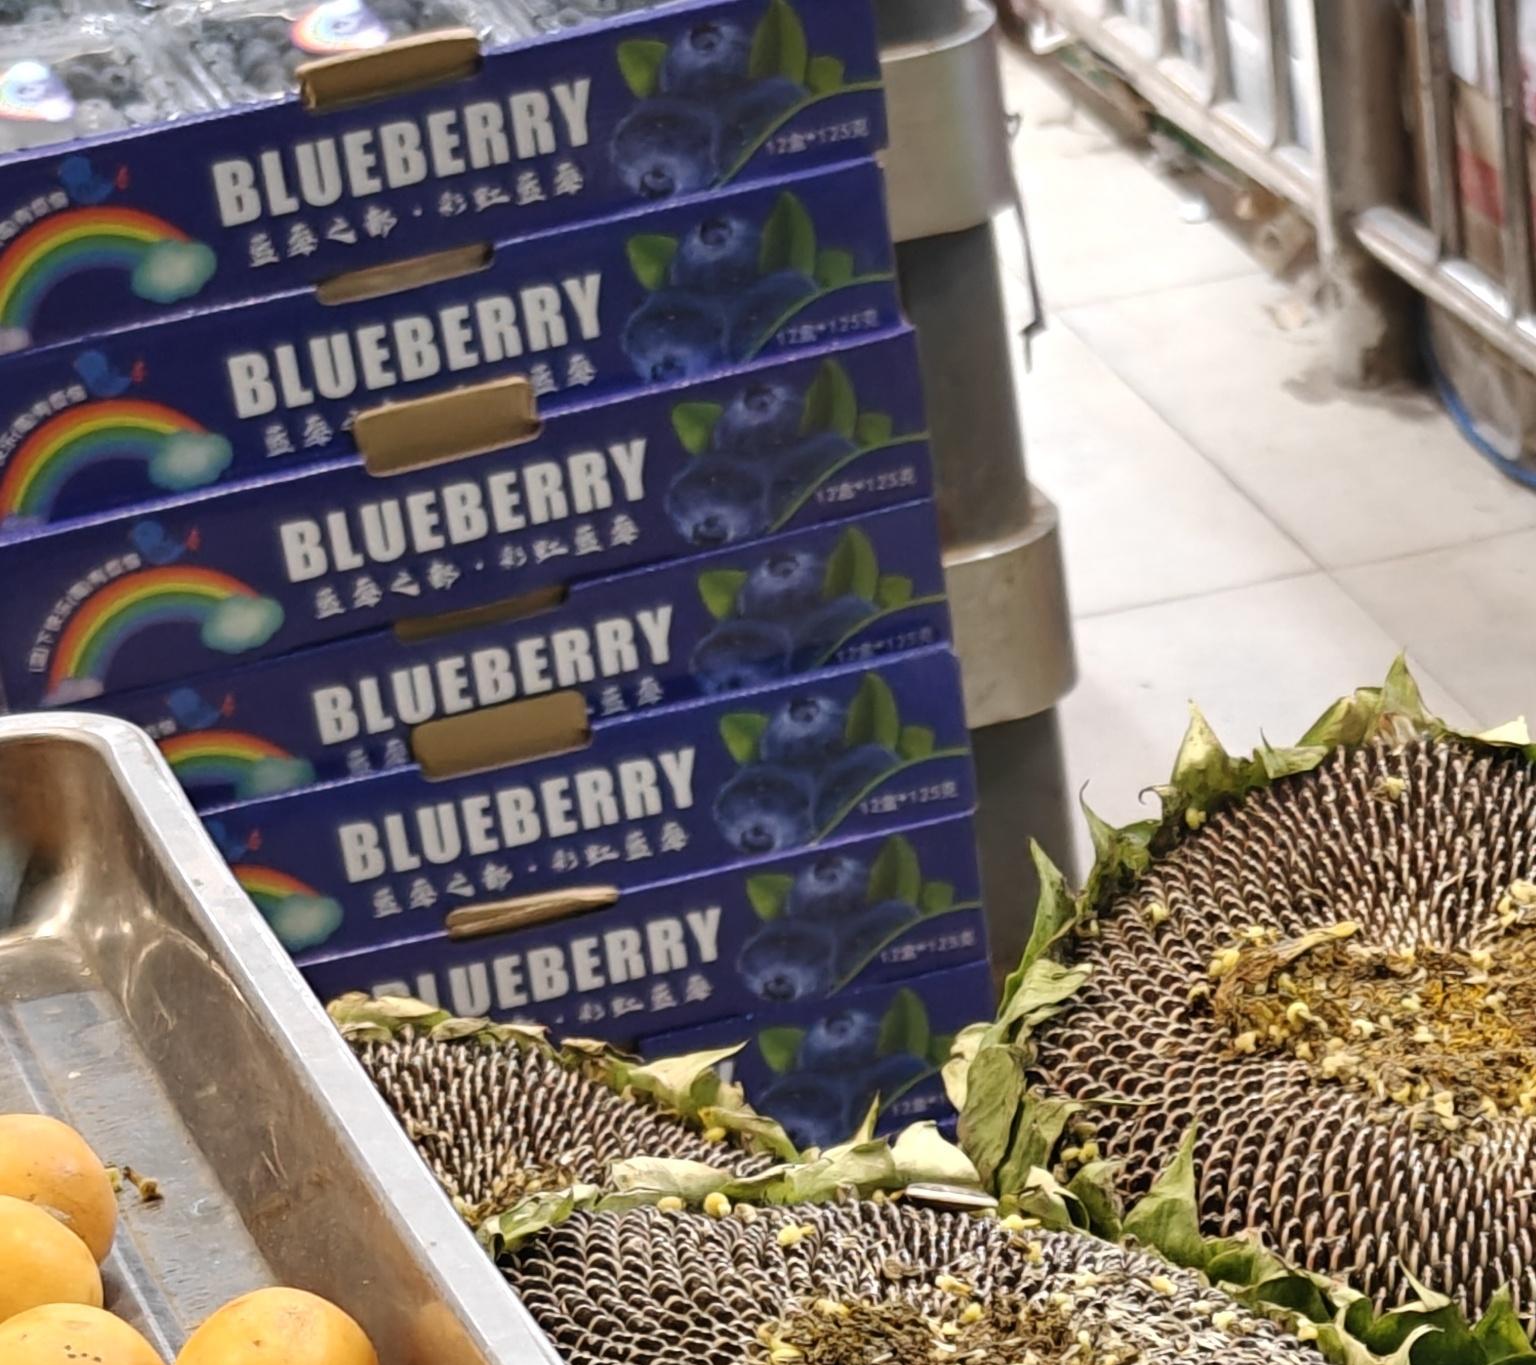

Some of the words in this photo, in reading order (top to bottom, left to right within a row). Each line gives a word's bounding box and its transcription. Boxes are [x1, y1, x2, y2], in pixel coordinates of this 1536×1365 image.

[212, 79, 590, 227] BLUEBERRY
[227, 272, 601, 419] BLUEBERRY
[279, 439, 646, 583] BLUEBERRY
[312, 604, 673, 745] BLUEBERRY
[337, 747, 695, 883] BLUEBERRY
